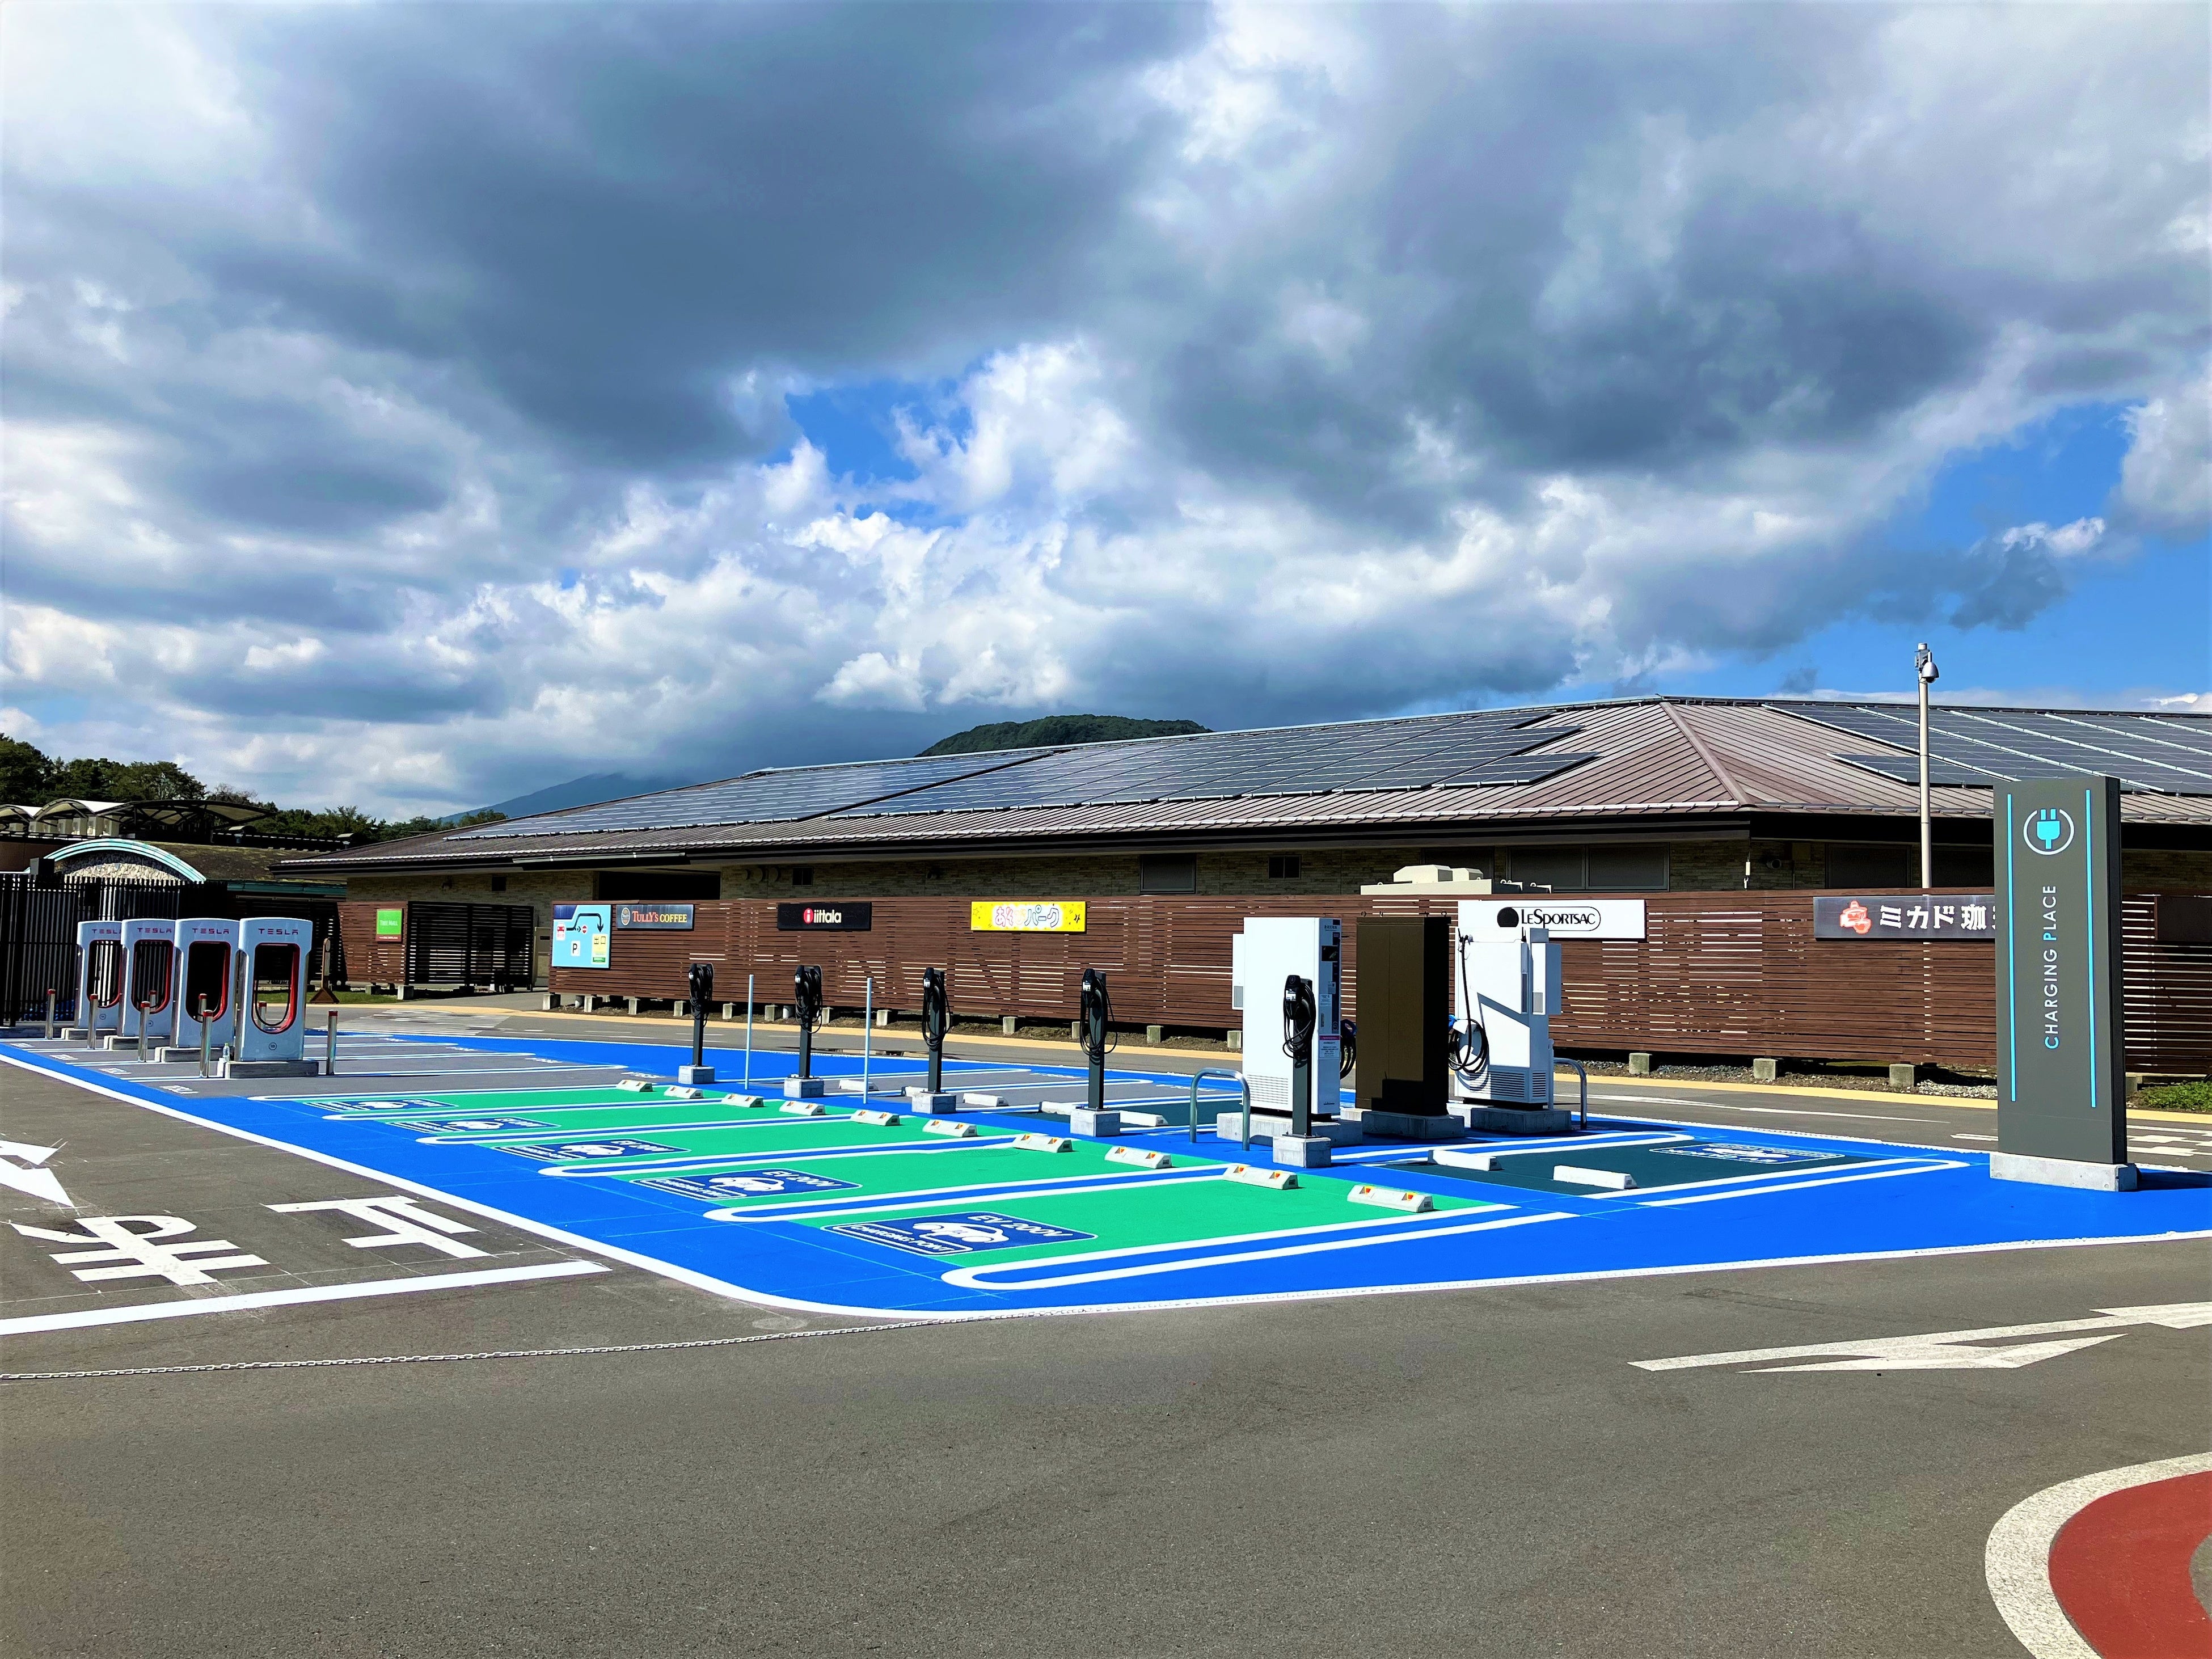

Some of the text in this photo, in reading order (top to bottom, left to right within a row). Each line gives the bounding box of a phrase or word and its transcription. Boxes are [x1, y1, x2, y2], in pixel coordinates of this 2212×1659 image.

[660, 913, 687, 923] COFFEE
[813, 909, 842, 923] iittala
[994, 904, 1059, 928] あそびパーク
[1880, 904, 1996, 930] ミカド珈
[572, 943, 578, 954] P
[2042, 885, 2061, 1050] CHARGING PLACE
[966, 1214, 1074, 1238] EV 200V
